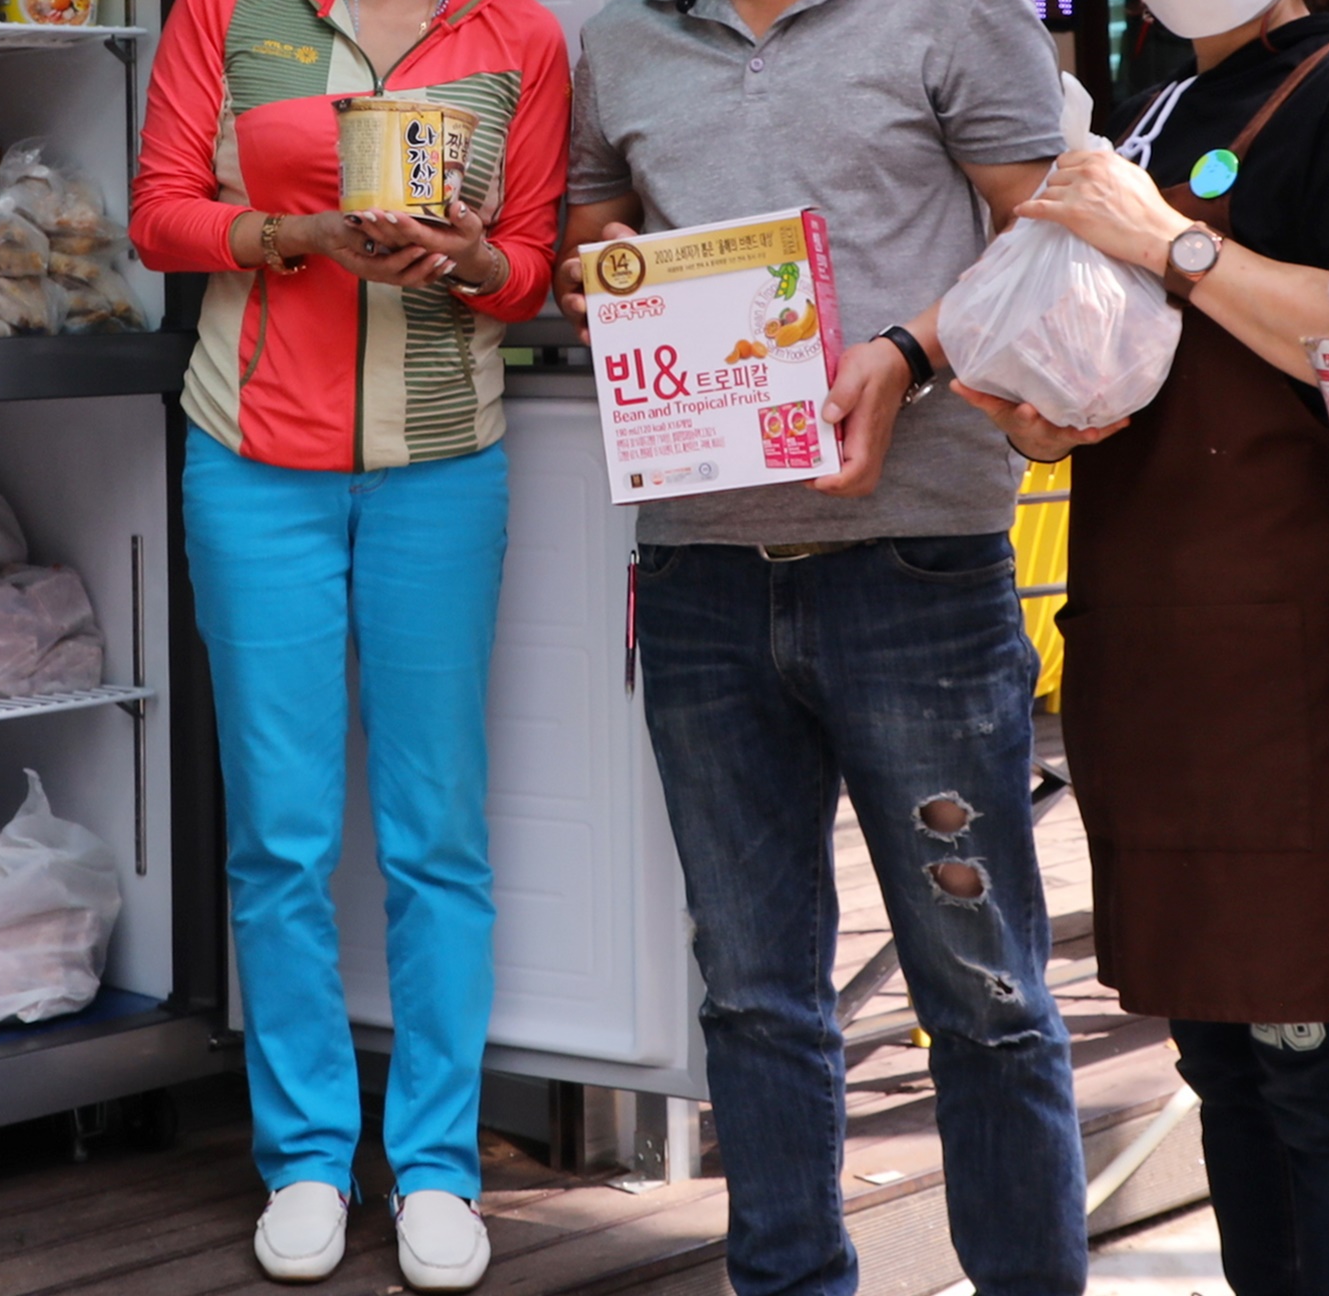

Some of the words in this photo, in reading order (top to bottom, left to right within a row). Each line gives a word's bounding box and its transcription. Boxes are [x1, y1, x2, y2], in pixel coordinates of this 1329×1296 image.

[406, 120, 438, 199] 나가사끼
[609, 252, 629, 272] 14
[598, 295, 666, 324] 삼육두유
[696, 363, 770, 394] 트로피칼
[613, 406, 646, 424] Bean
[647, 403, 672, 420] and
[676, 396, 728, 420] Tropical
[730, 390, 771, 407] Fruits
